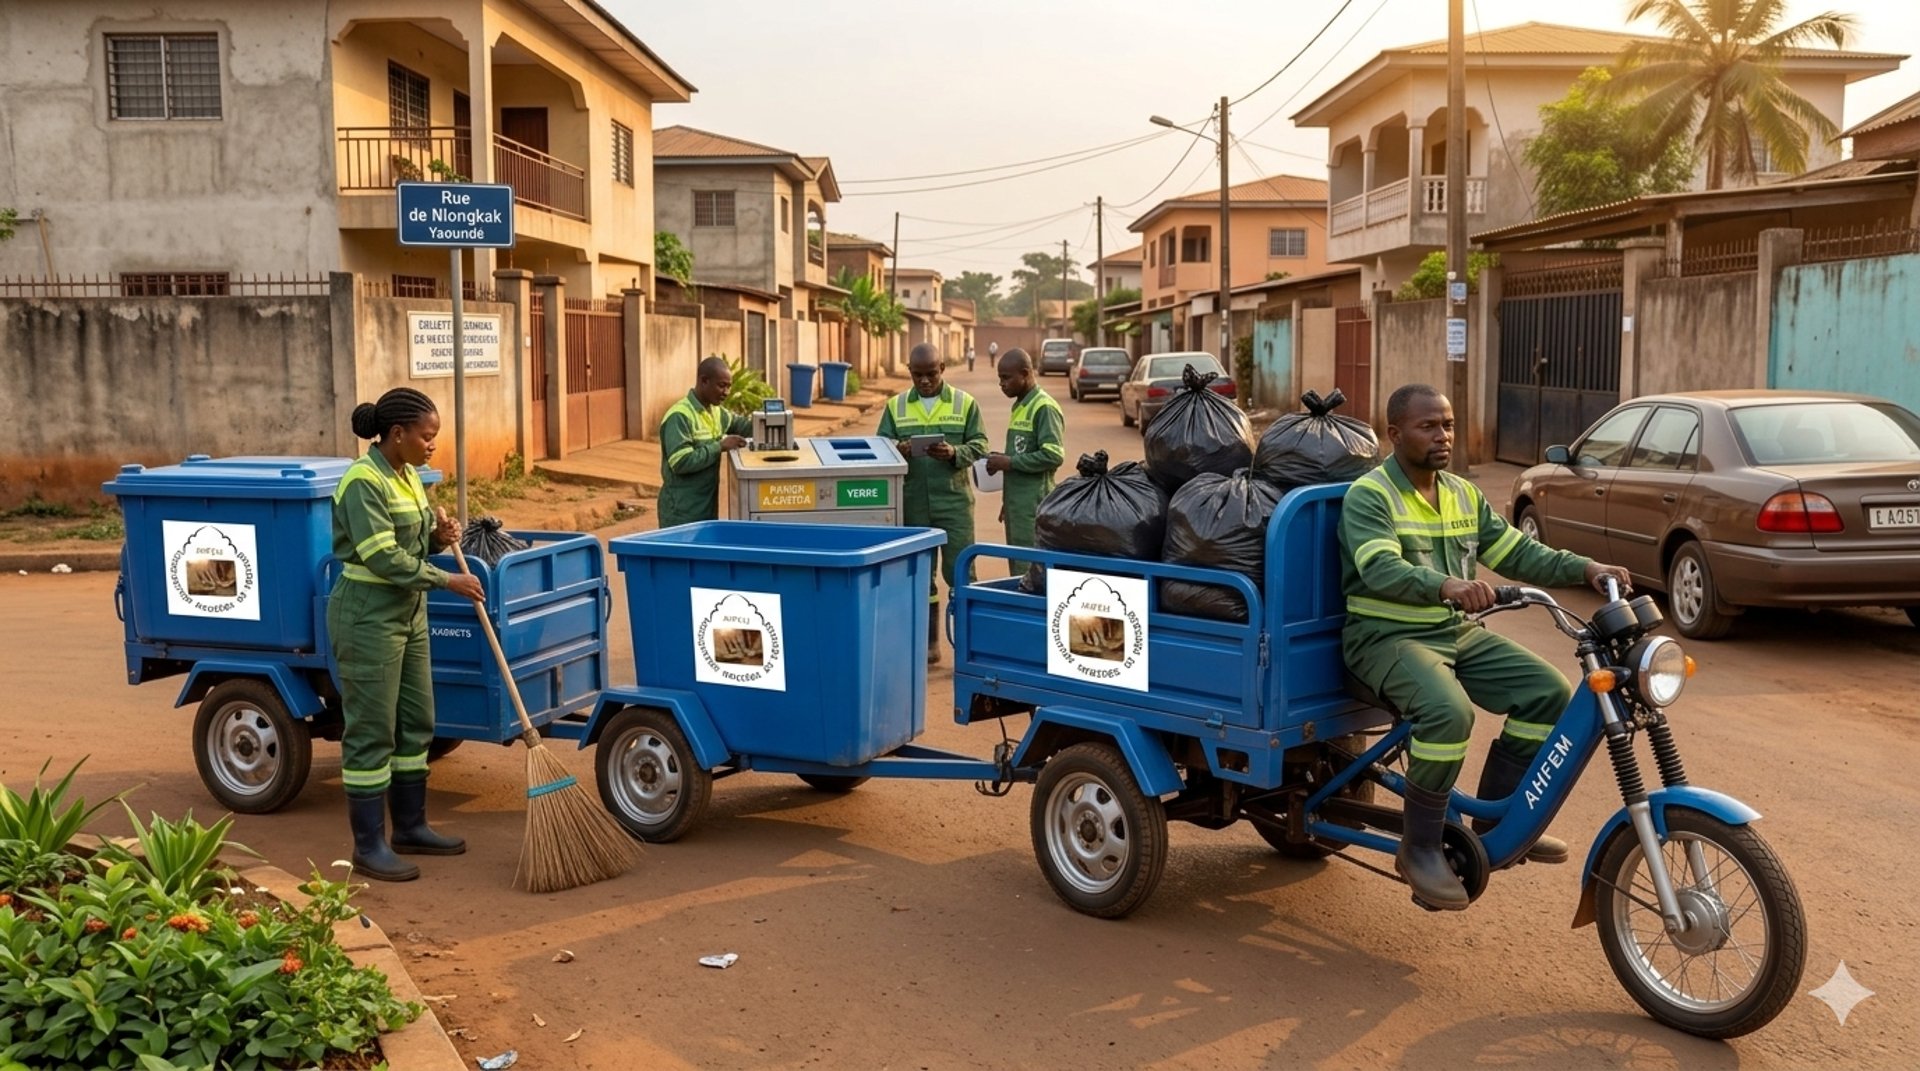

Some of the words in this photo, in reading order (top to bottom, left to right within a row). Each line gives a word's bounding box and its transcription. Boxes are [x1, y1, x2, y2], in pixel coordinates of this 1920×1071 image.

[441, 190, 471, 205] Rue
[409, 207, 427, 221] de
[429, 226, 485, 239] Yaoundé
[1525, 734, 1573, 810] AHFEM
